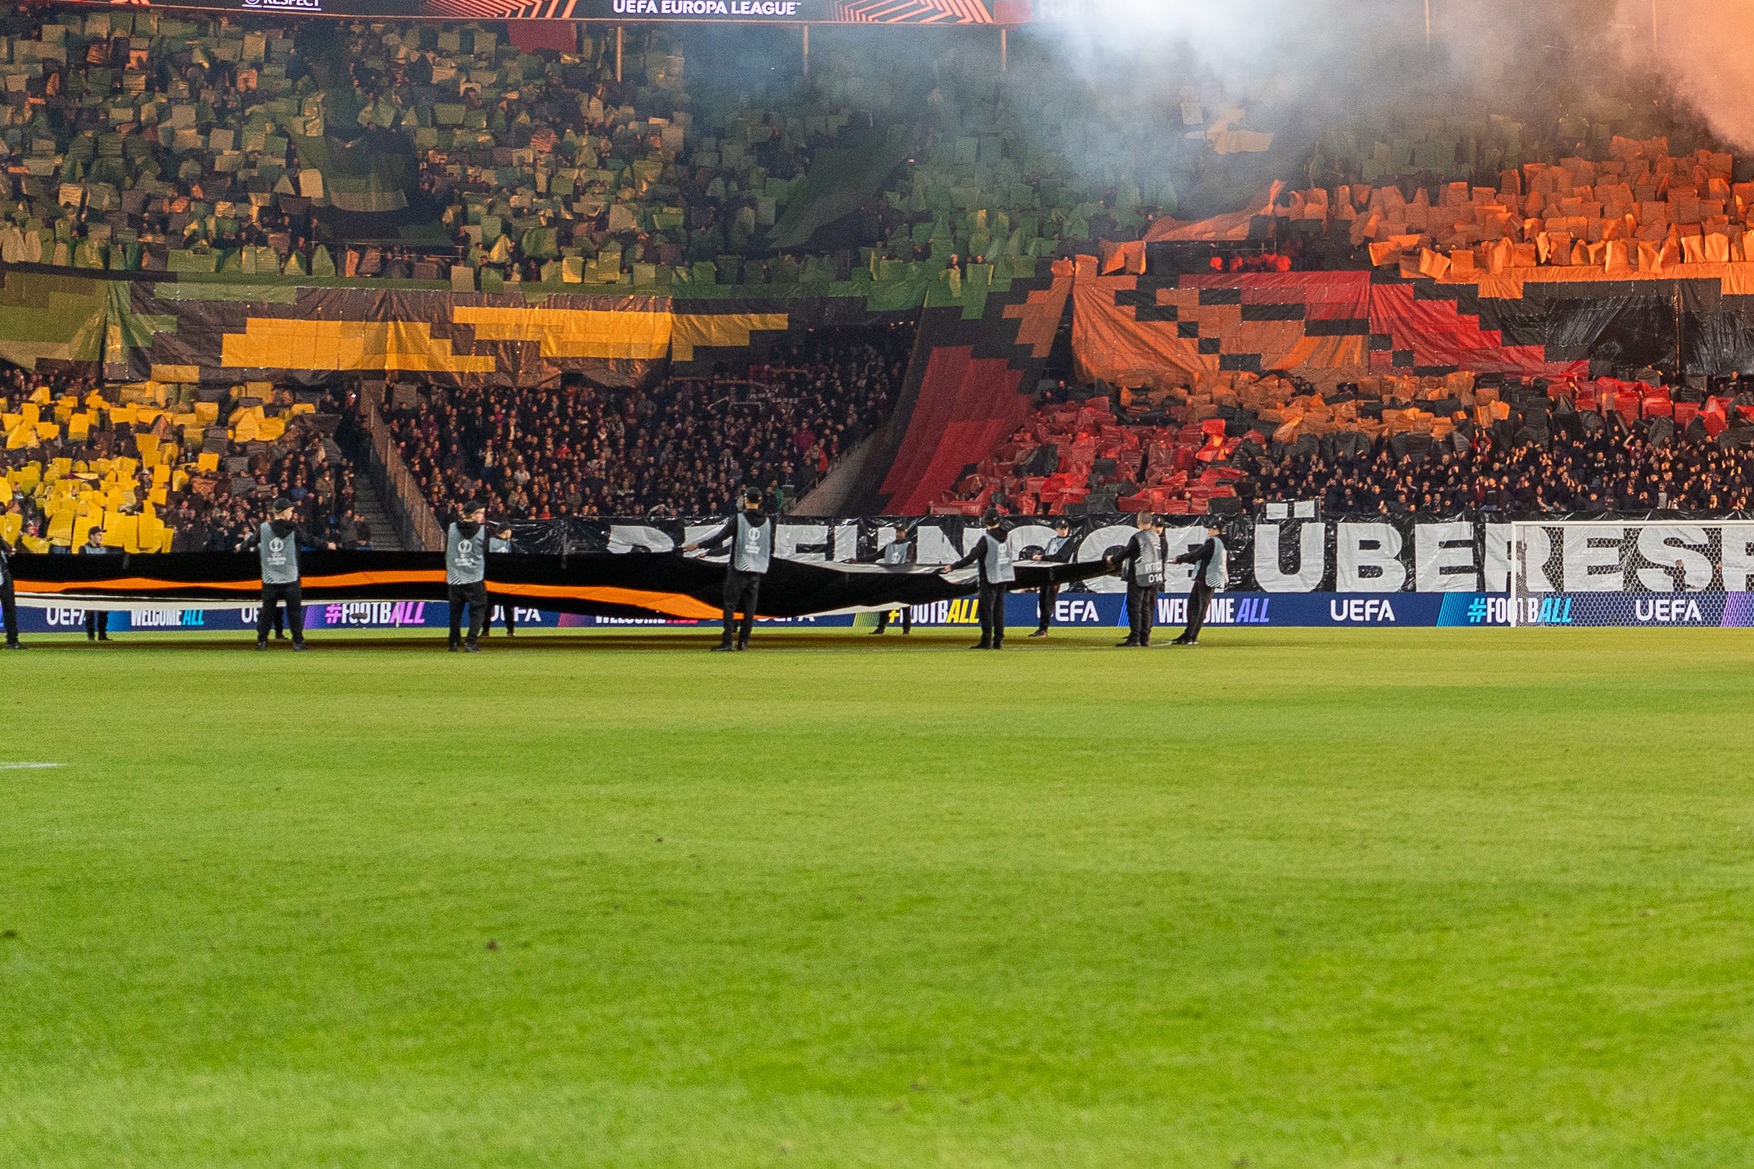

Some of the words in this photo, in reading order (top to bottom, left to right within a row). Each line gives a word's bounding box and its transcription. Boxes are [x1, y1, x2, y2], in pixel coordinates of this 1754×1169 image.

[612, 0, 658, 14] UEFA
[660, 0, 728, 15] EUROPA
[130, 609, 182, 626] WELCOME
[182, 609, 205, 626] ALL
[325, 601, 426, 624] #FOOTBALL
[1037, 600, 1100, 622] EFA
[1157, 598, 1235, 623] WELME
[1235, 598, 1270, 623] ALL
[1329, 599, 1396, 622] UEFA
[1635, 598, 1702, 621] UEFA
